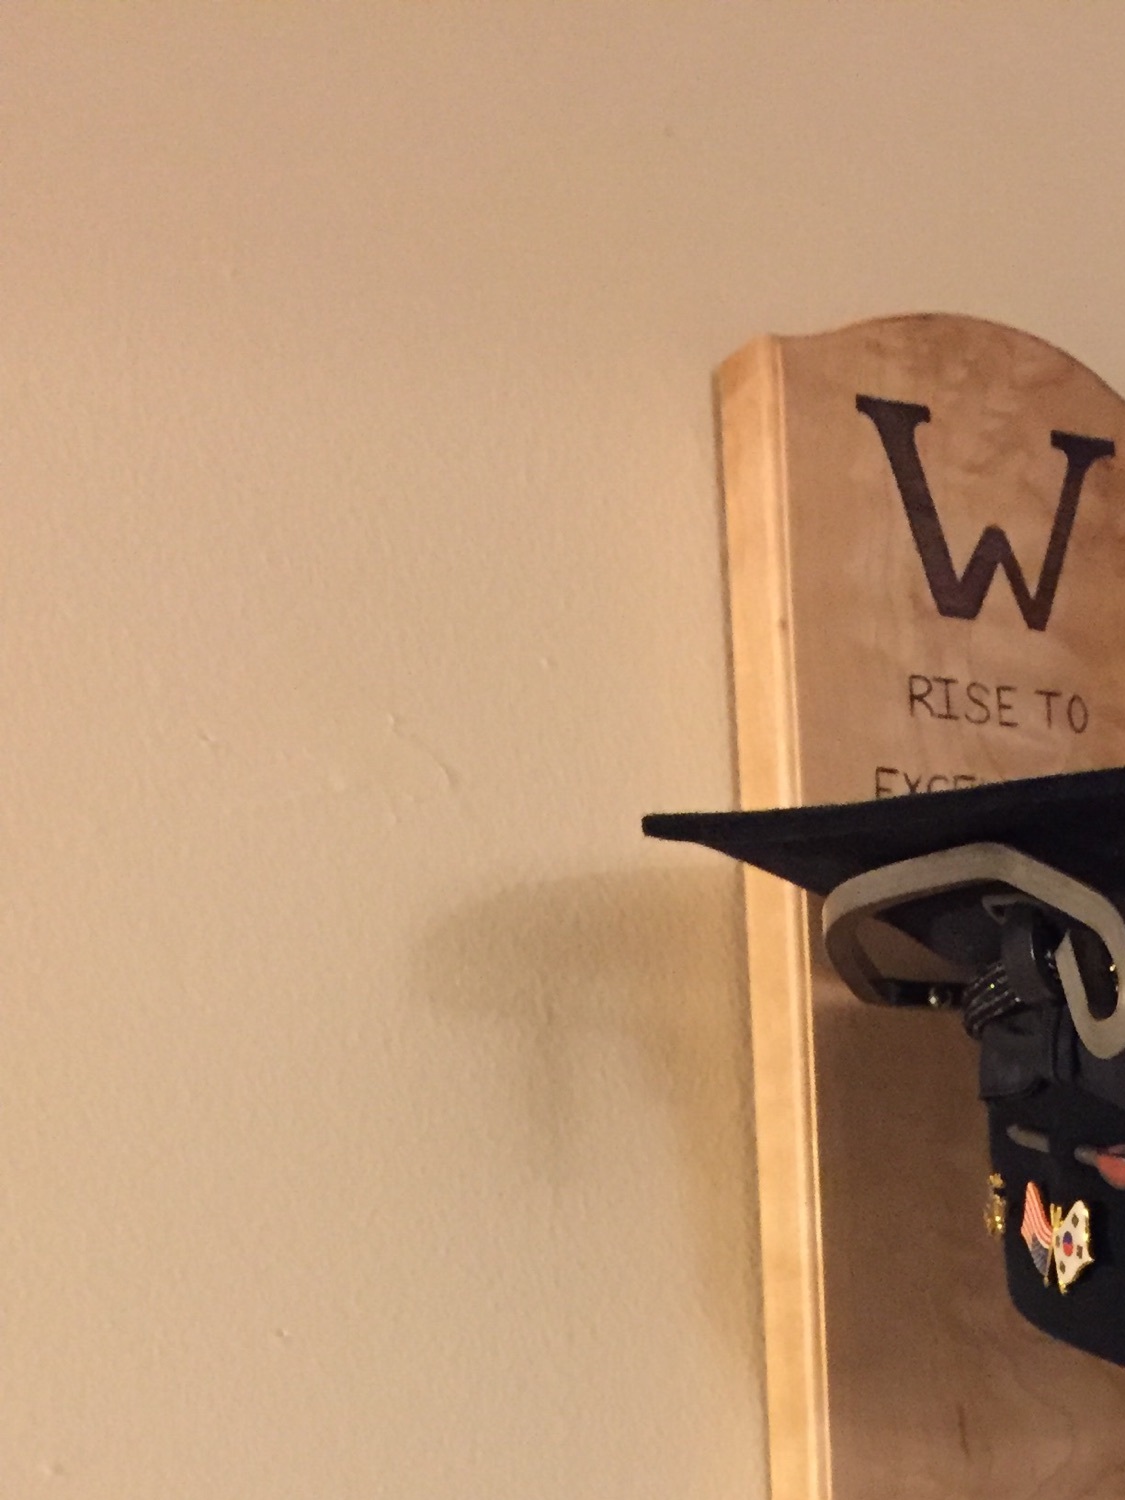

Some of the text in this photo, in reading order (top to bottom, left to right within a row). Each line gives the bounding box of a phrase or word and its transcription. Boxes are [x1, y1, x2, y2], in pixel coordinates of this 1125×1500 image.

[855, 393, 1115, 632] W
[908, 674, 1089, 735] RISE TO
